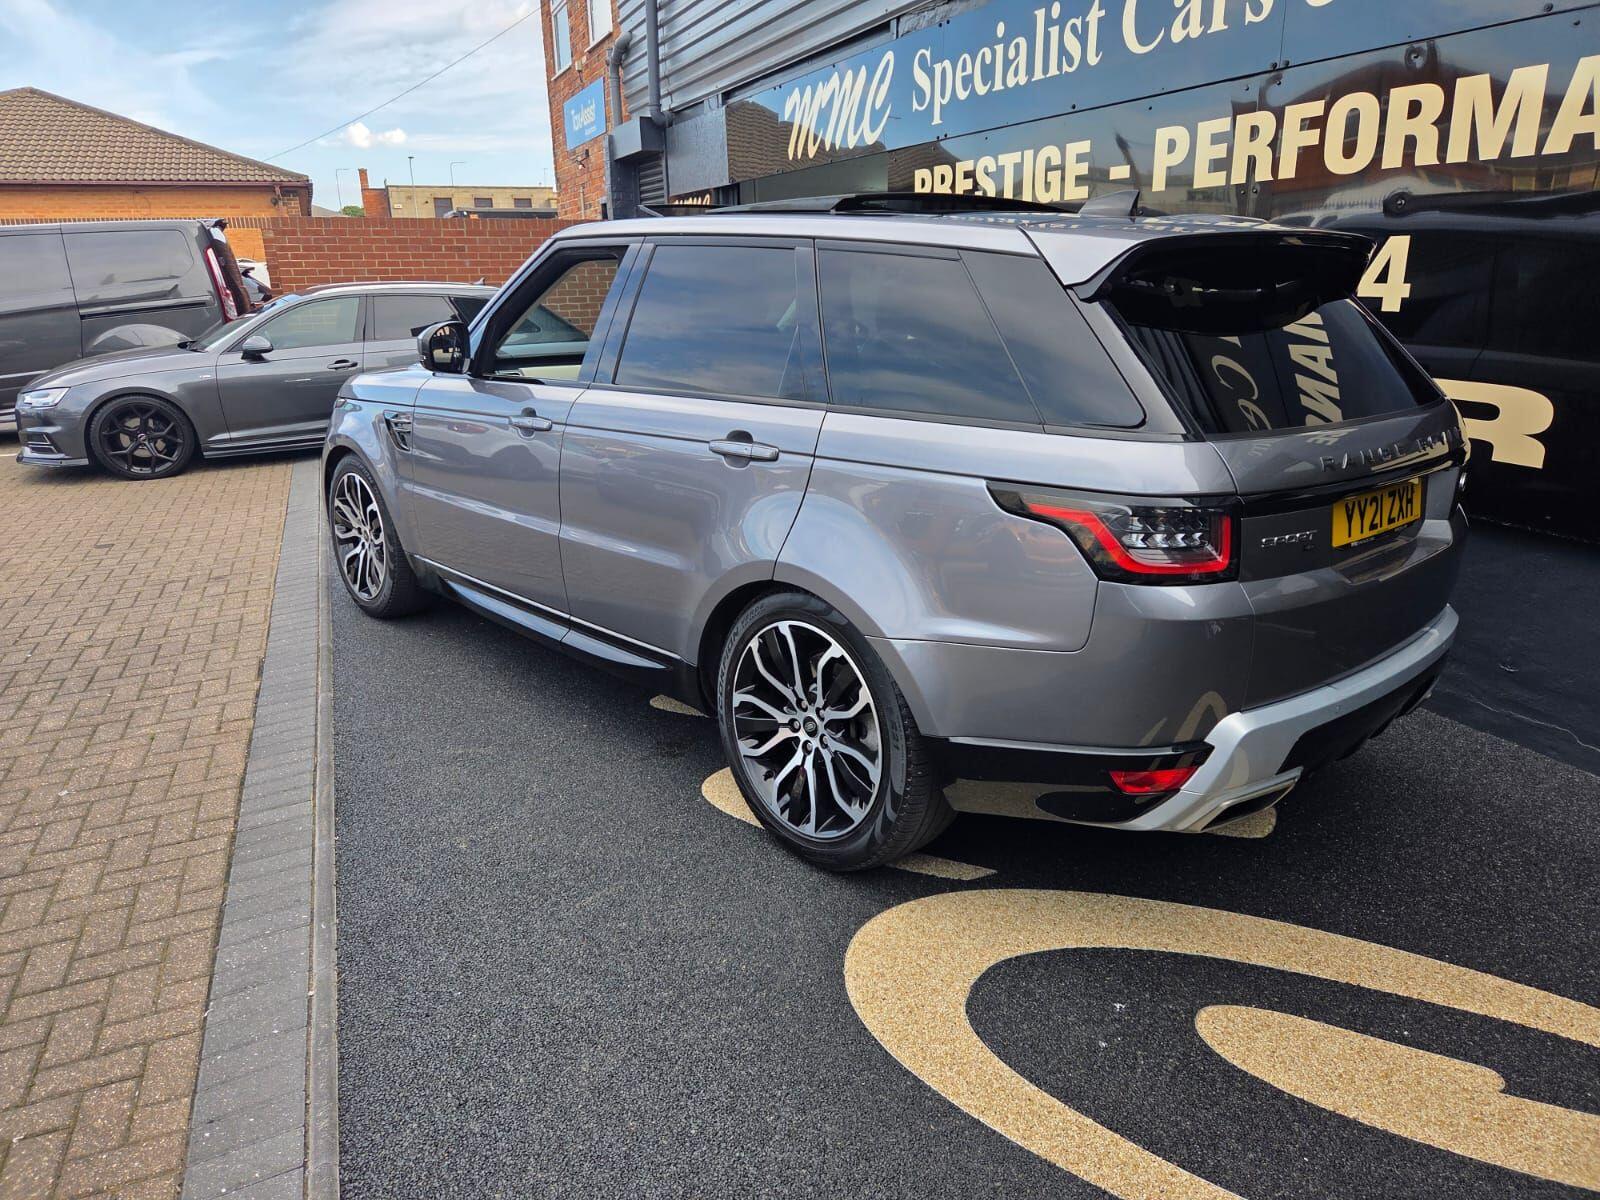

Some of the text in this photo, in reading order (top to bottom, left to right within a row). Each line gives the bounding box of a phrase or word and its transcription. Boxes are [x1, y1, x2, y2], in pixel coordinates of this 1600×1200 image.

[912, 0, 1106, 126] Specialist
[1121, 0, 1273, 54] Cars
[914, 140, 1091, 203] PRESTIGE
[1319, 442, 1407, 472] RANGE
[1344, 485, 1413, 538] YY21 ZXH
[1261, 529, 1318, 548] SPORT
